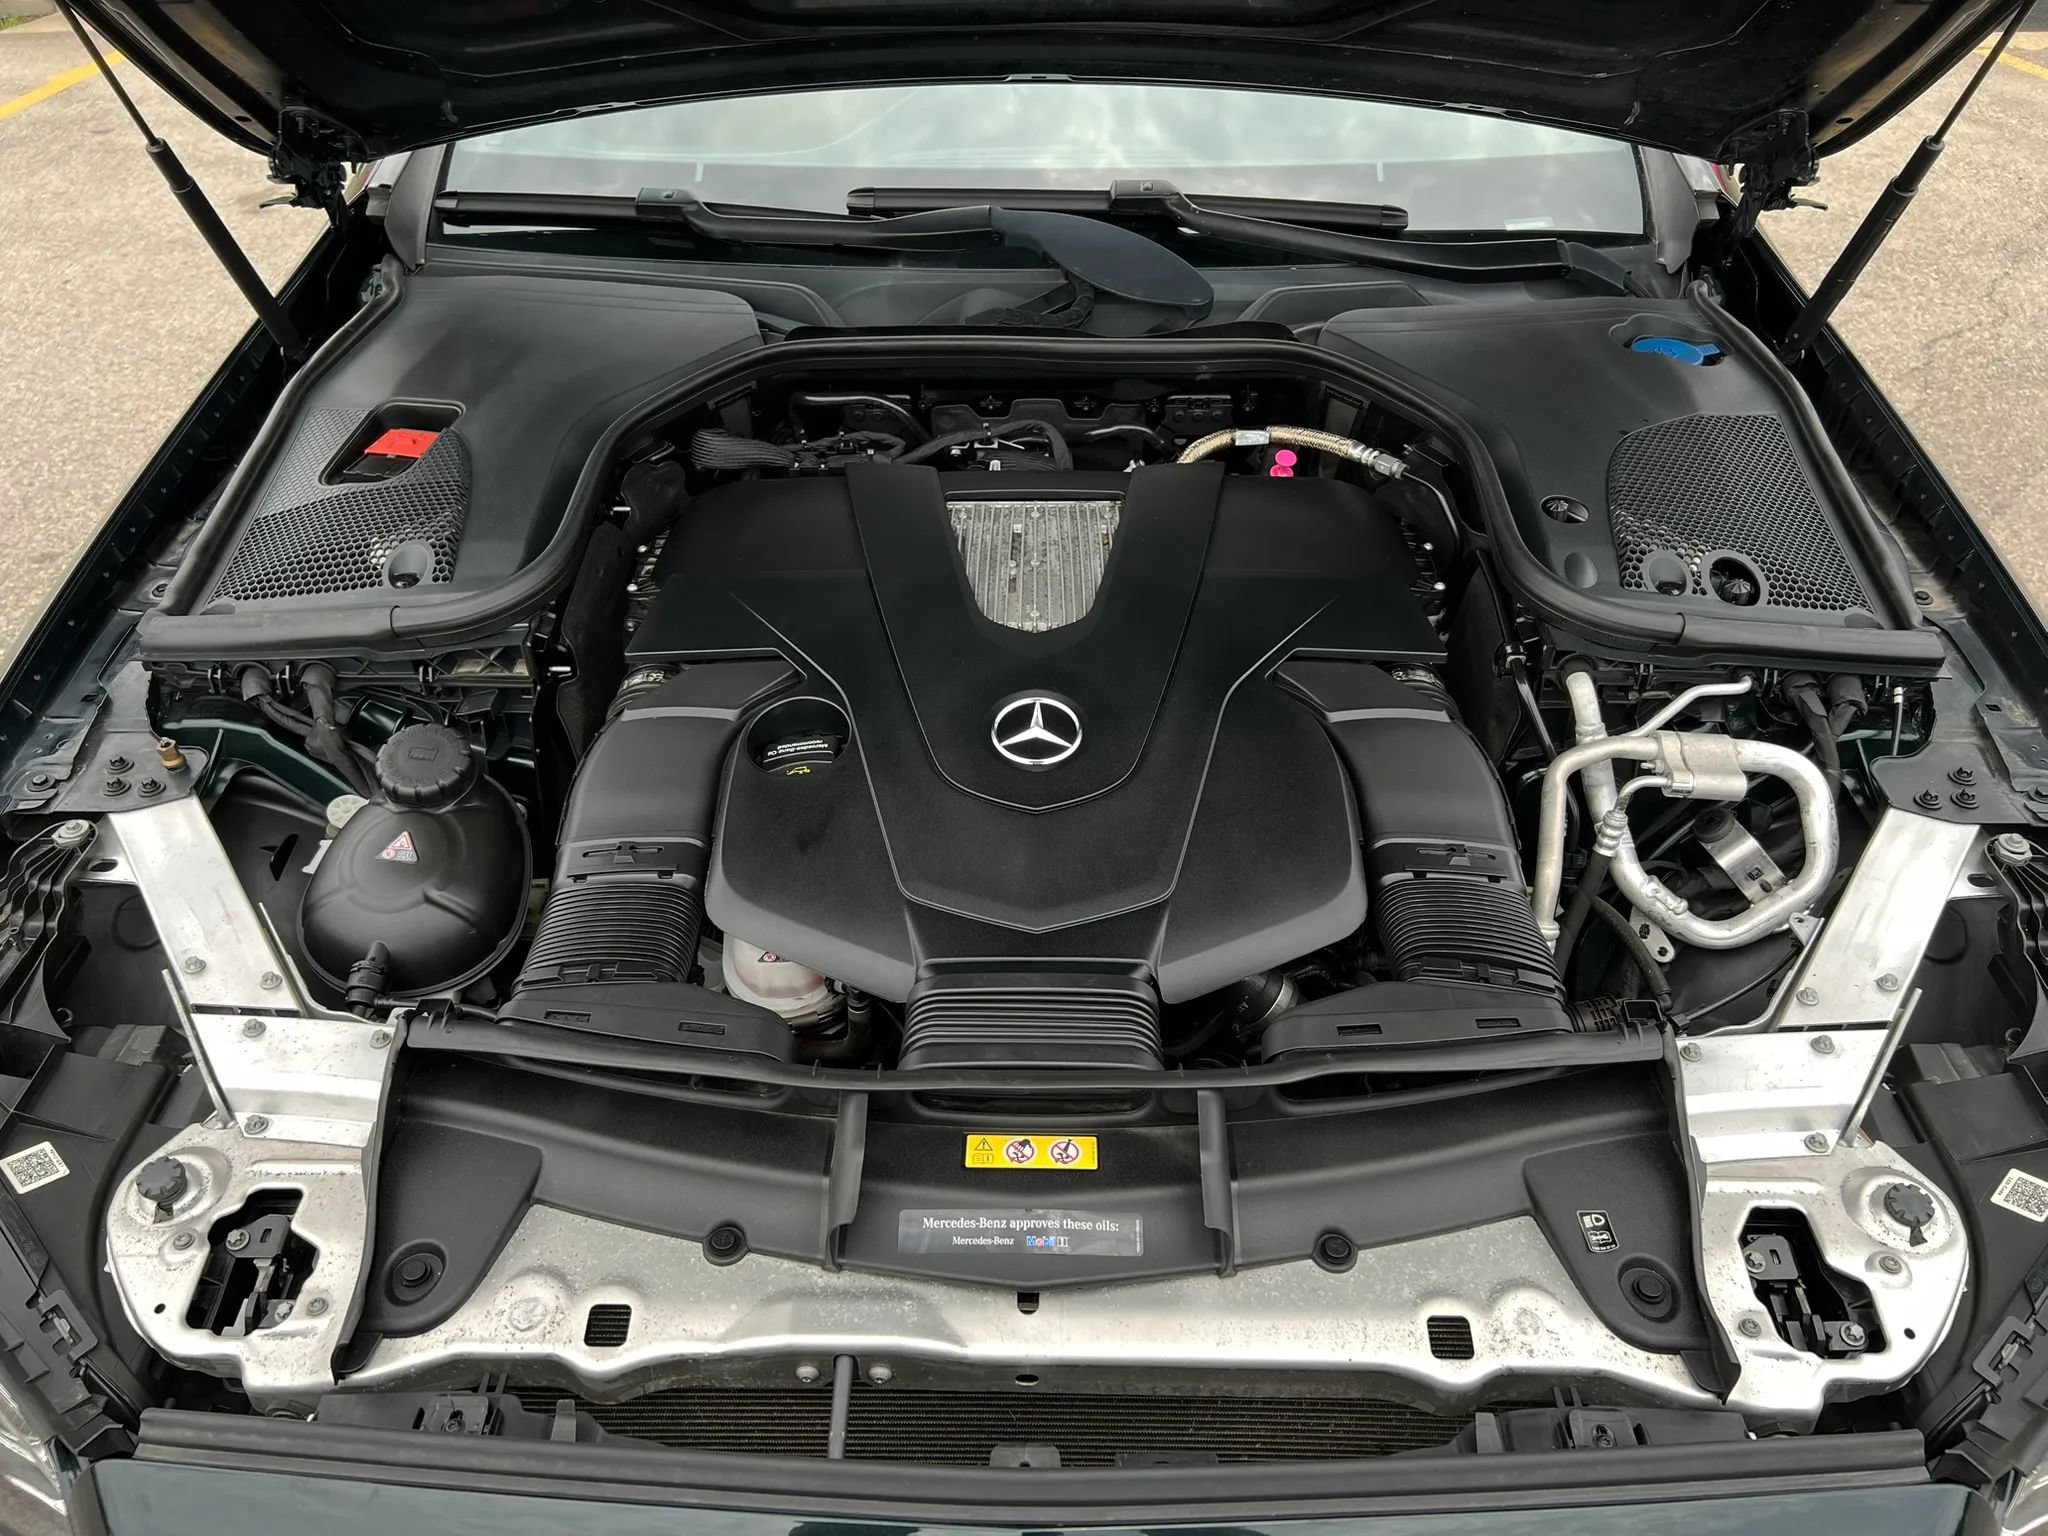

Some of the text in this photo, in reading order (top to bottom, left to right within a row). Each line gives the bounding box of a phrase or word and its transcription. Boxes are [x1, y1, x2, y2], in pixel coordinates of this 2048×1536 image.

[922, 1217, 1119, 1232] Mercedes-Benz approves these oils:
[952, 1236, 1015, 1246] Mercedes-Benz
[1026, 1236, 1056, 1247] Mobil
